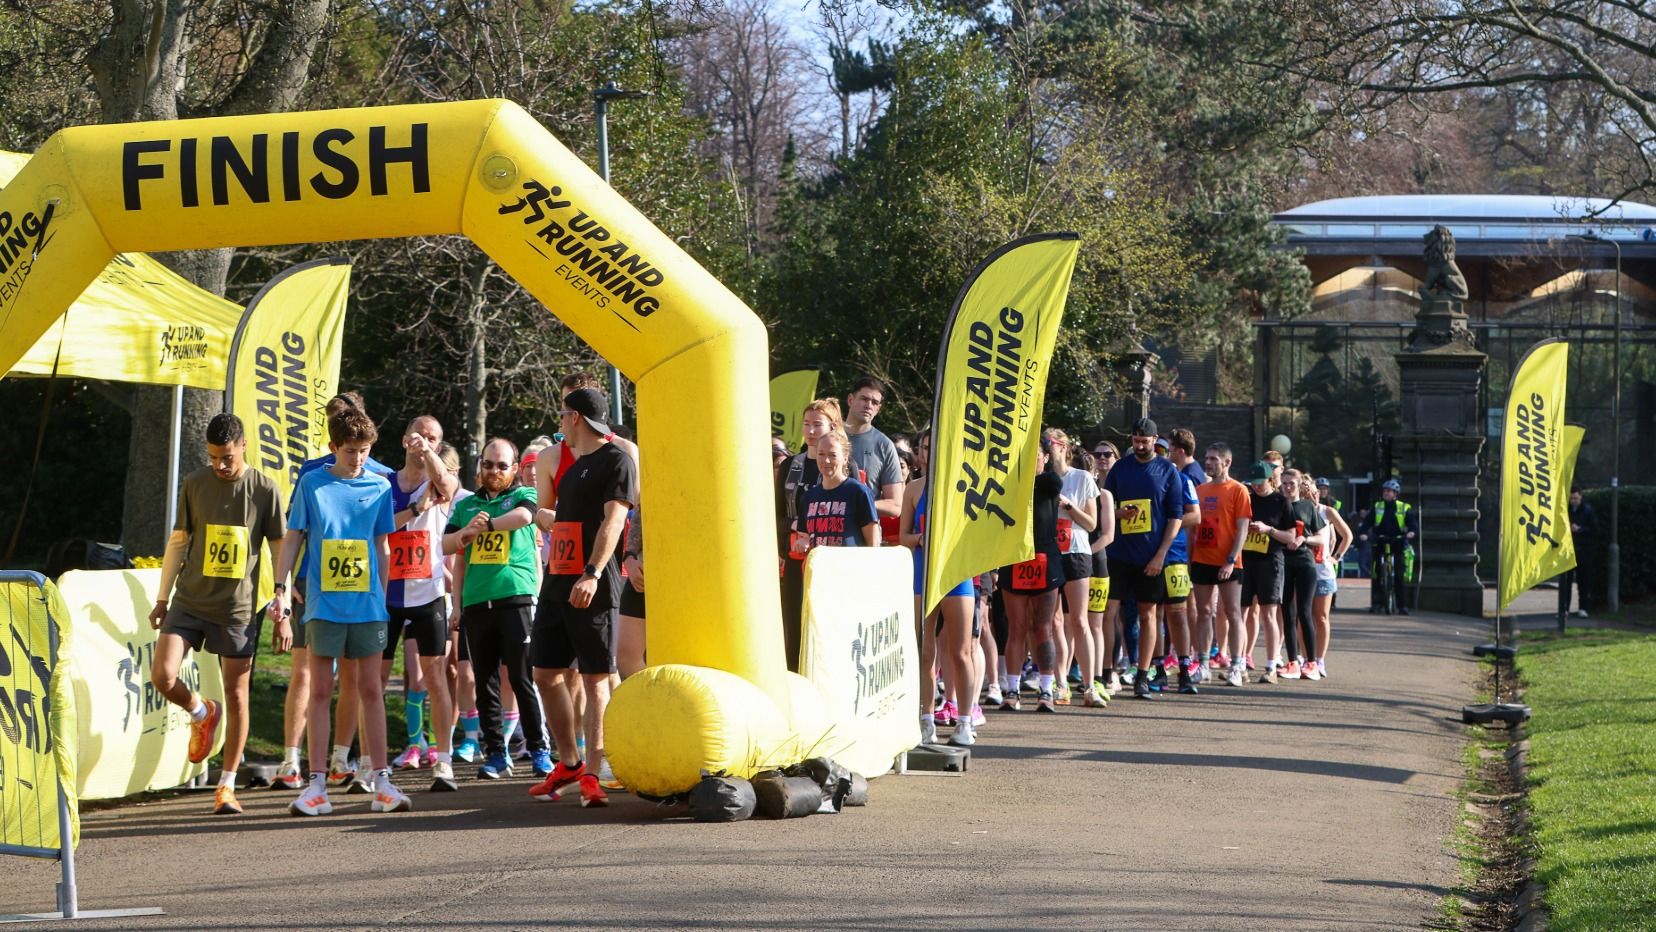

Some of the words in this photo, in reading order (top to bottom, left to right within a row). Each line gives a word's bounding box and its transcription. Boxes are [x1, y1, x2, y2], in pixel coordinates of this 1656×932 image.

[123, 123, 430, 211] FINISH
[537, 220, 660, 317] RUNNING
[567, 208, 611, 242] UP
[599, 238, 665, 287] AND
[0, 261, 31, 307] ENTS
[554, 264, 611, 308] EVENTS
[173, 343, 208, 361] RUNNING
[966, 320, 994, 402] AND
[255, 346, 282, 424] AND
[987, 306, 1025, 475] RUNNING
[1018, 358, 1038, 432] EVENTS
[259, 423, 285, 471] UP
[962, 402, 988, 452] UP
[1516, 403, 1532, 461] AND
[1530, 392, 1552, 510] RUNNING
[1518, 461, 1535, 496] UP
[209, 542, 238, 564] 961
[394, 546, 426, 566] 219
[476, 533, 504, 552] 962
[553, 539, 576, 561] 192
[329, 556, 363, 578] 965
[1018, 565, 1042, 579] 204
[1170, 575, 1189, 588] 979
[1088, 588, 1107, 602] 994
[871, 620, 884, 657] UP
[868, 645, 904, 698] RUNNING
